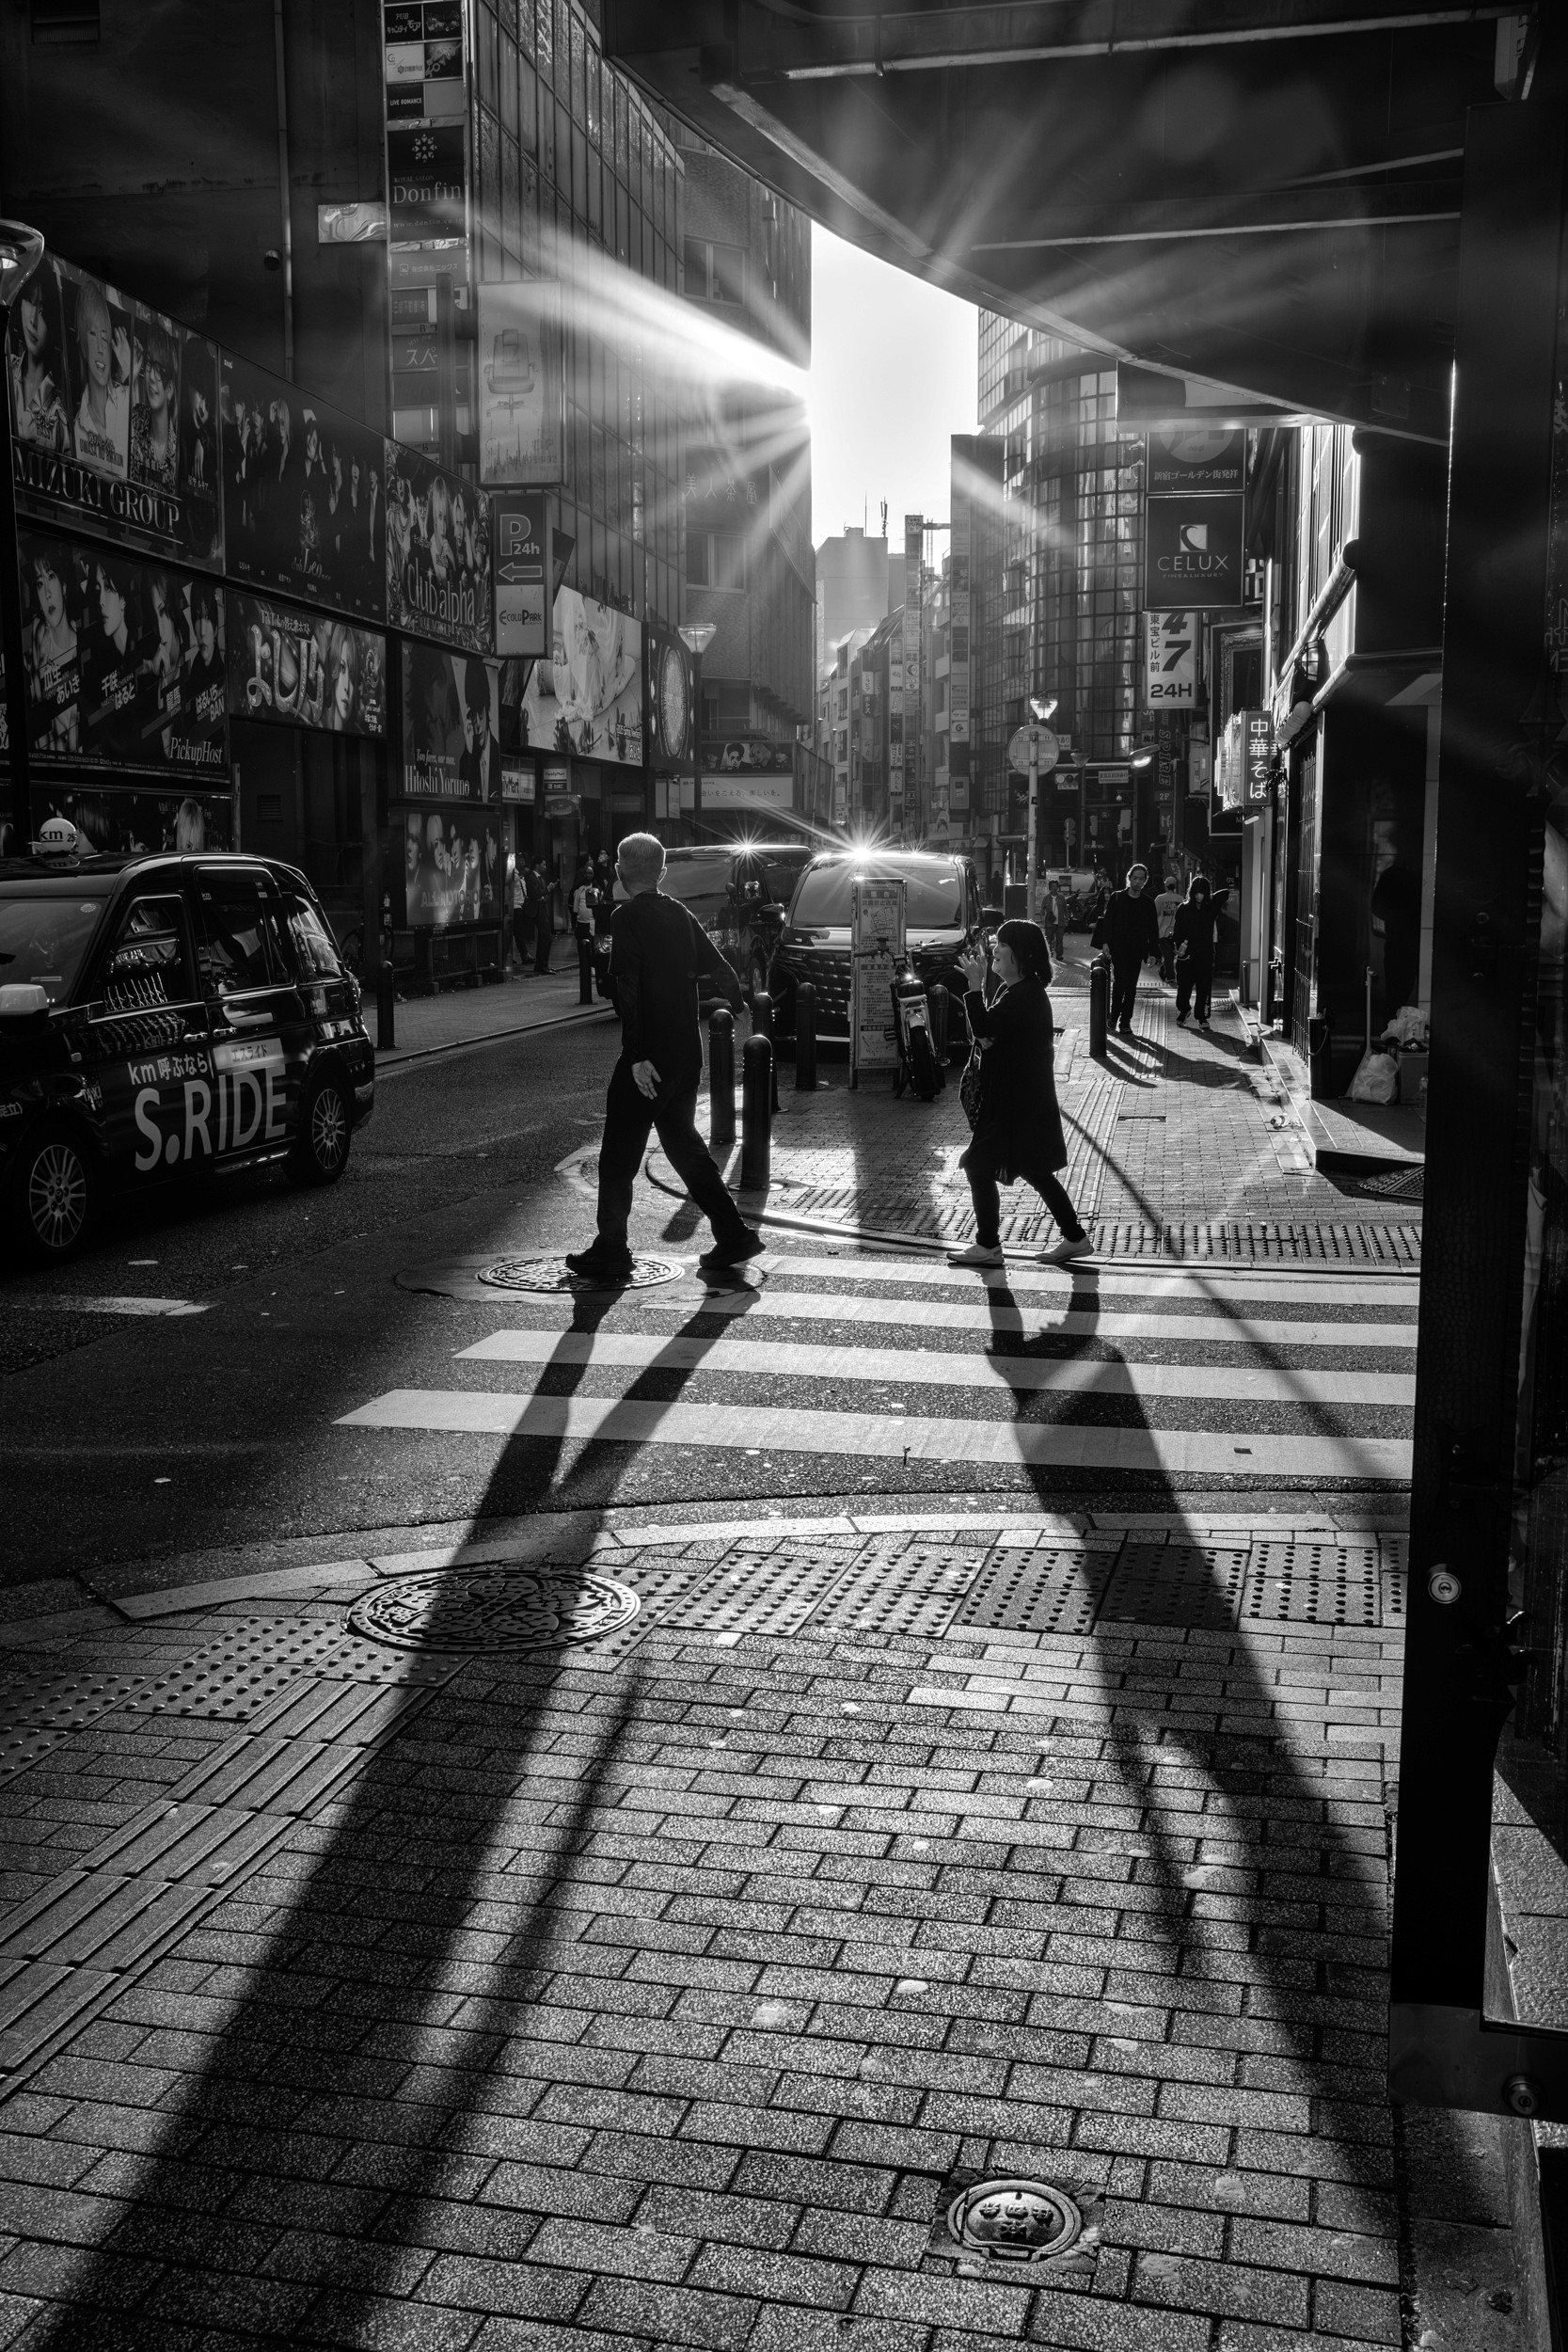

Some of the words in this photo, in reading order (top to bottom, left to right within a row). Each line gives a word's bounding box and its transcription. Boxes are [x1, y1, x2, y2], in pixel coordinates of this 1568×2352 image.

[392, 182, 463, 204] Donfin
[14, 446, 103, 509] MIZUKI
[109, 482, 181, 533] GROUP
[499, 514, 531, 556] P
[514, 543, 541, 555] 24h
[1157, 555, 1228, 571] CELUX
[1149, 613, 1161, 673] 東宝ビル前
[56, 675, 80, 705] あいき
[114, 681, 135, 710] はると
[196, 682, 218, 715] はるいち
[1150, 683, 1192, 698] 24H
[210, 694, 225, 723] BAN
[404, 764, 438, 794] Hitoshi
[40, 831, 63, 840] km
[134, 1065, 287, 1172] S.RIDE
